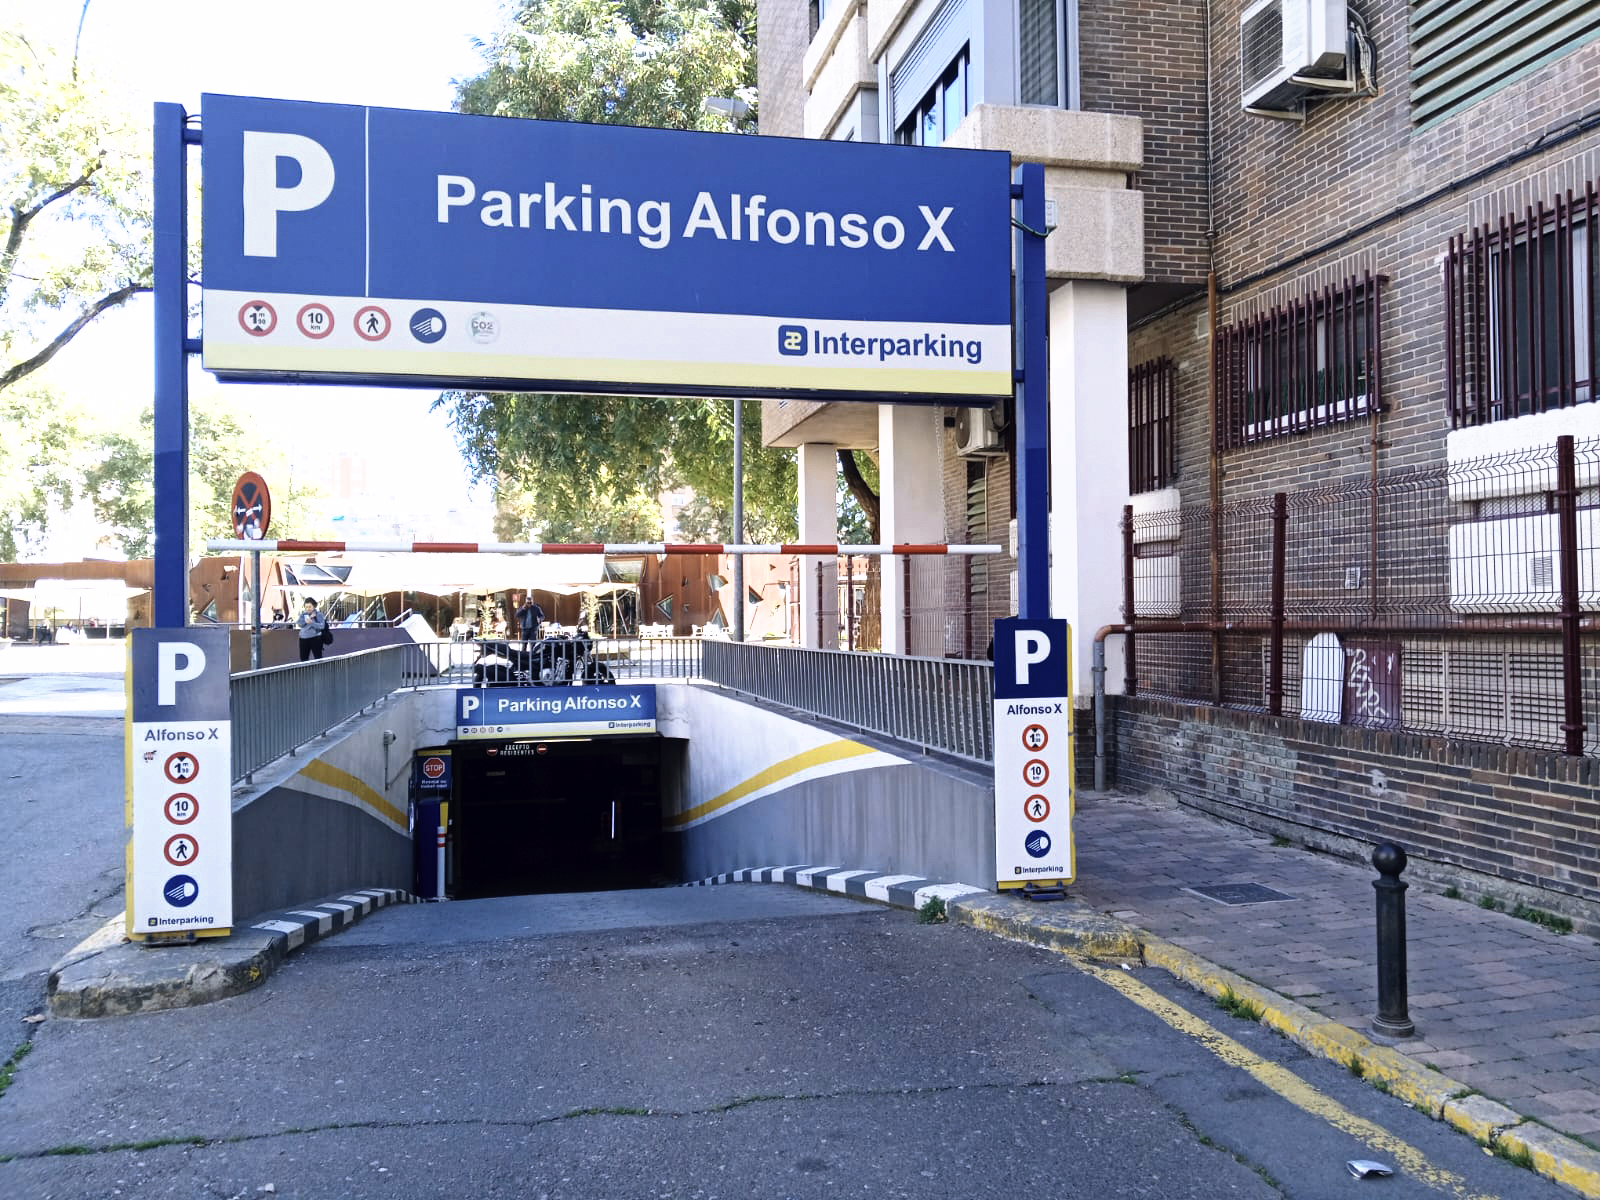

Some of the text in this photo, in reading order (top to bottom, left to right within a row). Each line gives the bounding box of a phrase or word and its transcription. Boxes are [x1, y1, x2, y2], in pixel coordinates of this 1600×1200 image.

[243, 131, 336, 258] P
[437, 174, 956, 252] Parking Alfonso X
[307, 312, 323, 324] 10
[471, 320, 493, 330] CO2
[814, 330, 983, 364] Interparking
[1014, 629, 1051, 685] P
[157, 641, 206, 706] P
[462, 695, 480, 720] P
[498, 694, 642, 714] Parking Alfonso X
[1006, 703, 1063, 716] Alfonso X
[144, 727, 219, 742] Alfonso X
[425, 764, 443, 772] STOP
[1031, 766, 1042, 776] 10
[174, 800, 189, 812] 10
[1022, 865, 1064, 874] Interparking
[159, 915, 214, 926] Interparking
